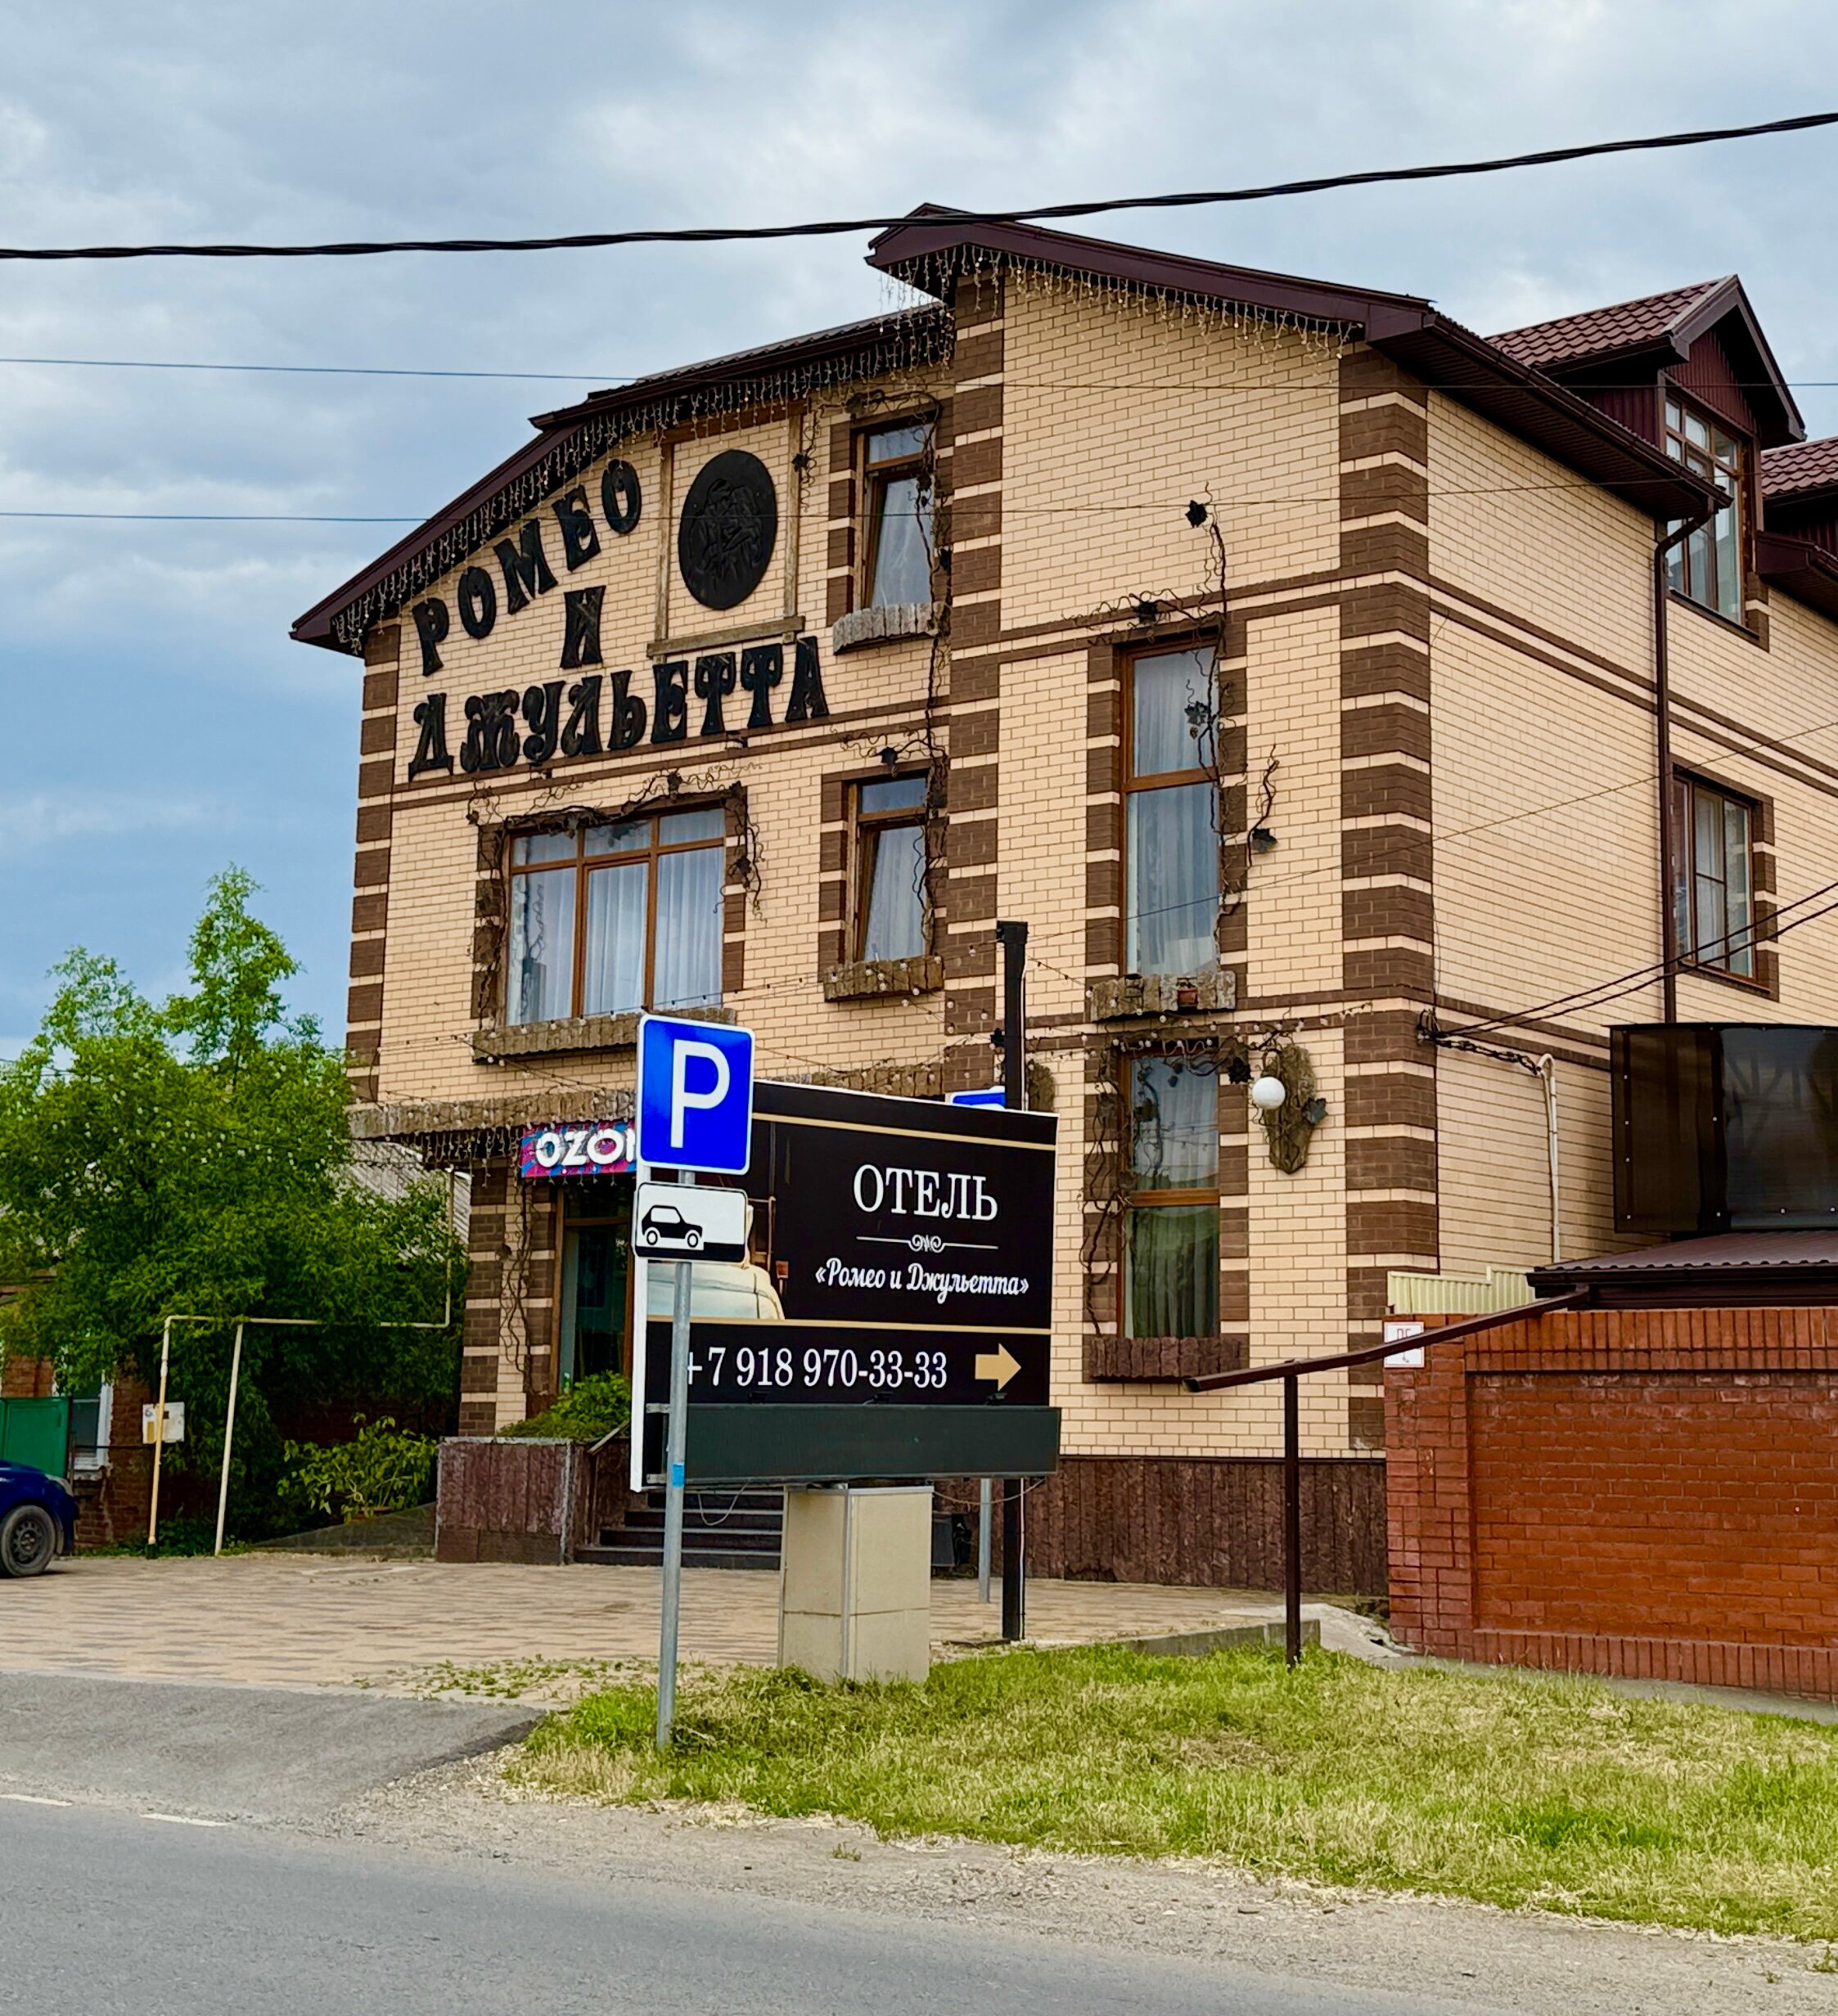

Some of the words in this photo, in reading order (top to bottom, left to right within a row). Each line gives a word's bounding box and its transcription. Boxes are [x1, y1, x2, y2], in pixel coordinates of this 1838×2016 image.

[412, 458, 642, 676] РОМЕО
[560, 585, 606, 668] И
[408, 636, 830, 782] ДЖУЛЬЕТТА
[670, 1038, 731, 1149] P
[854, 1164, 998, 1221] ОТЕЛЬ
[815, 1257, 885, 1289] «Ромео
[890, 1270, 902, 1289] и
[906, 1262, 1029, 1304] Джульетта»
[736, 1347, 793, 1387] 918
[803, 1348, 947, 1388] 970-33-33
